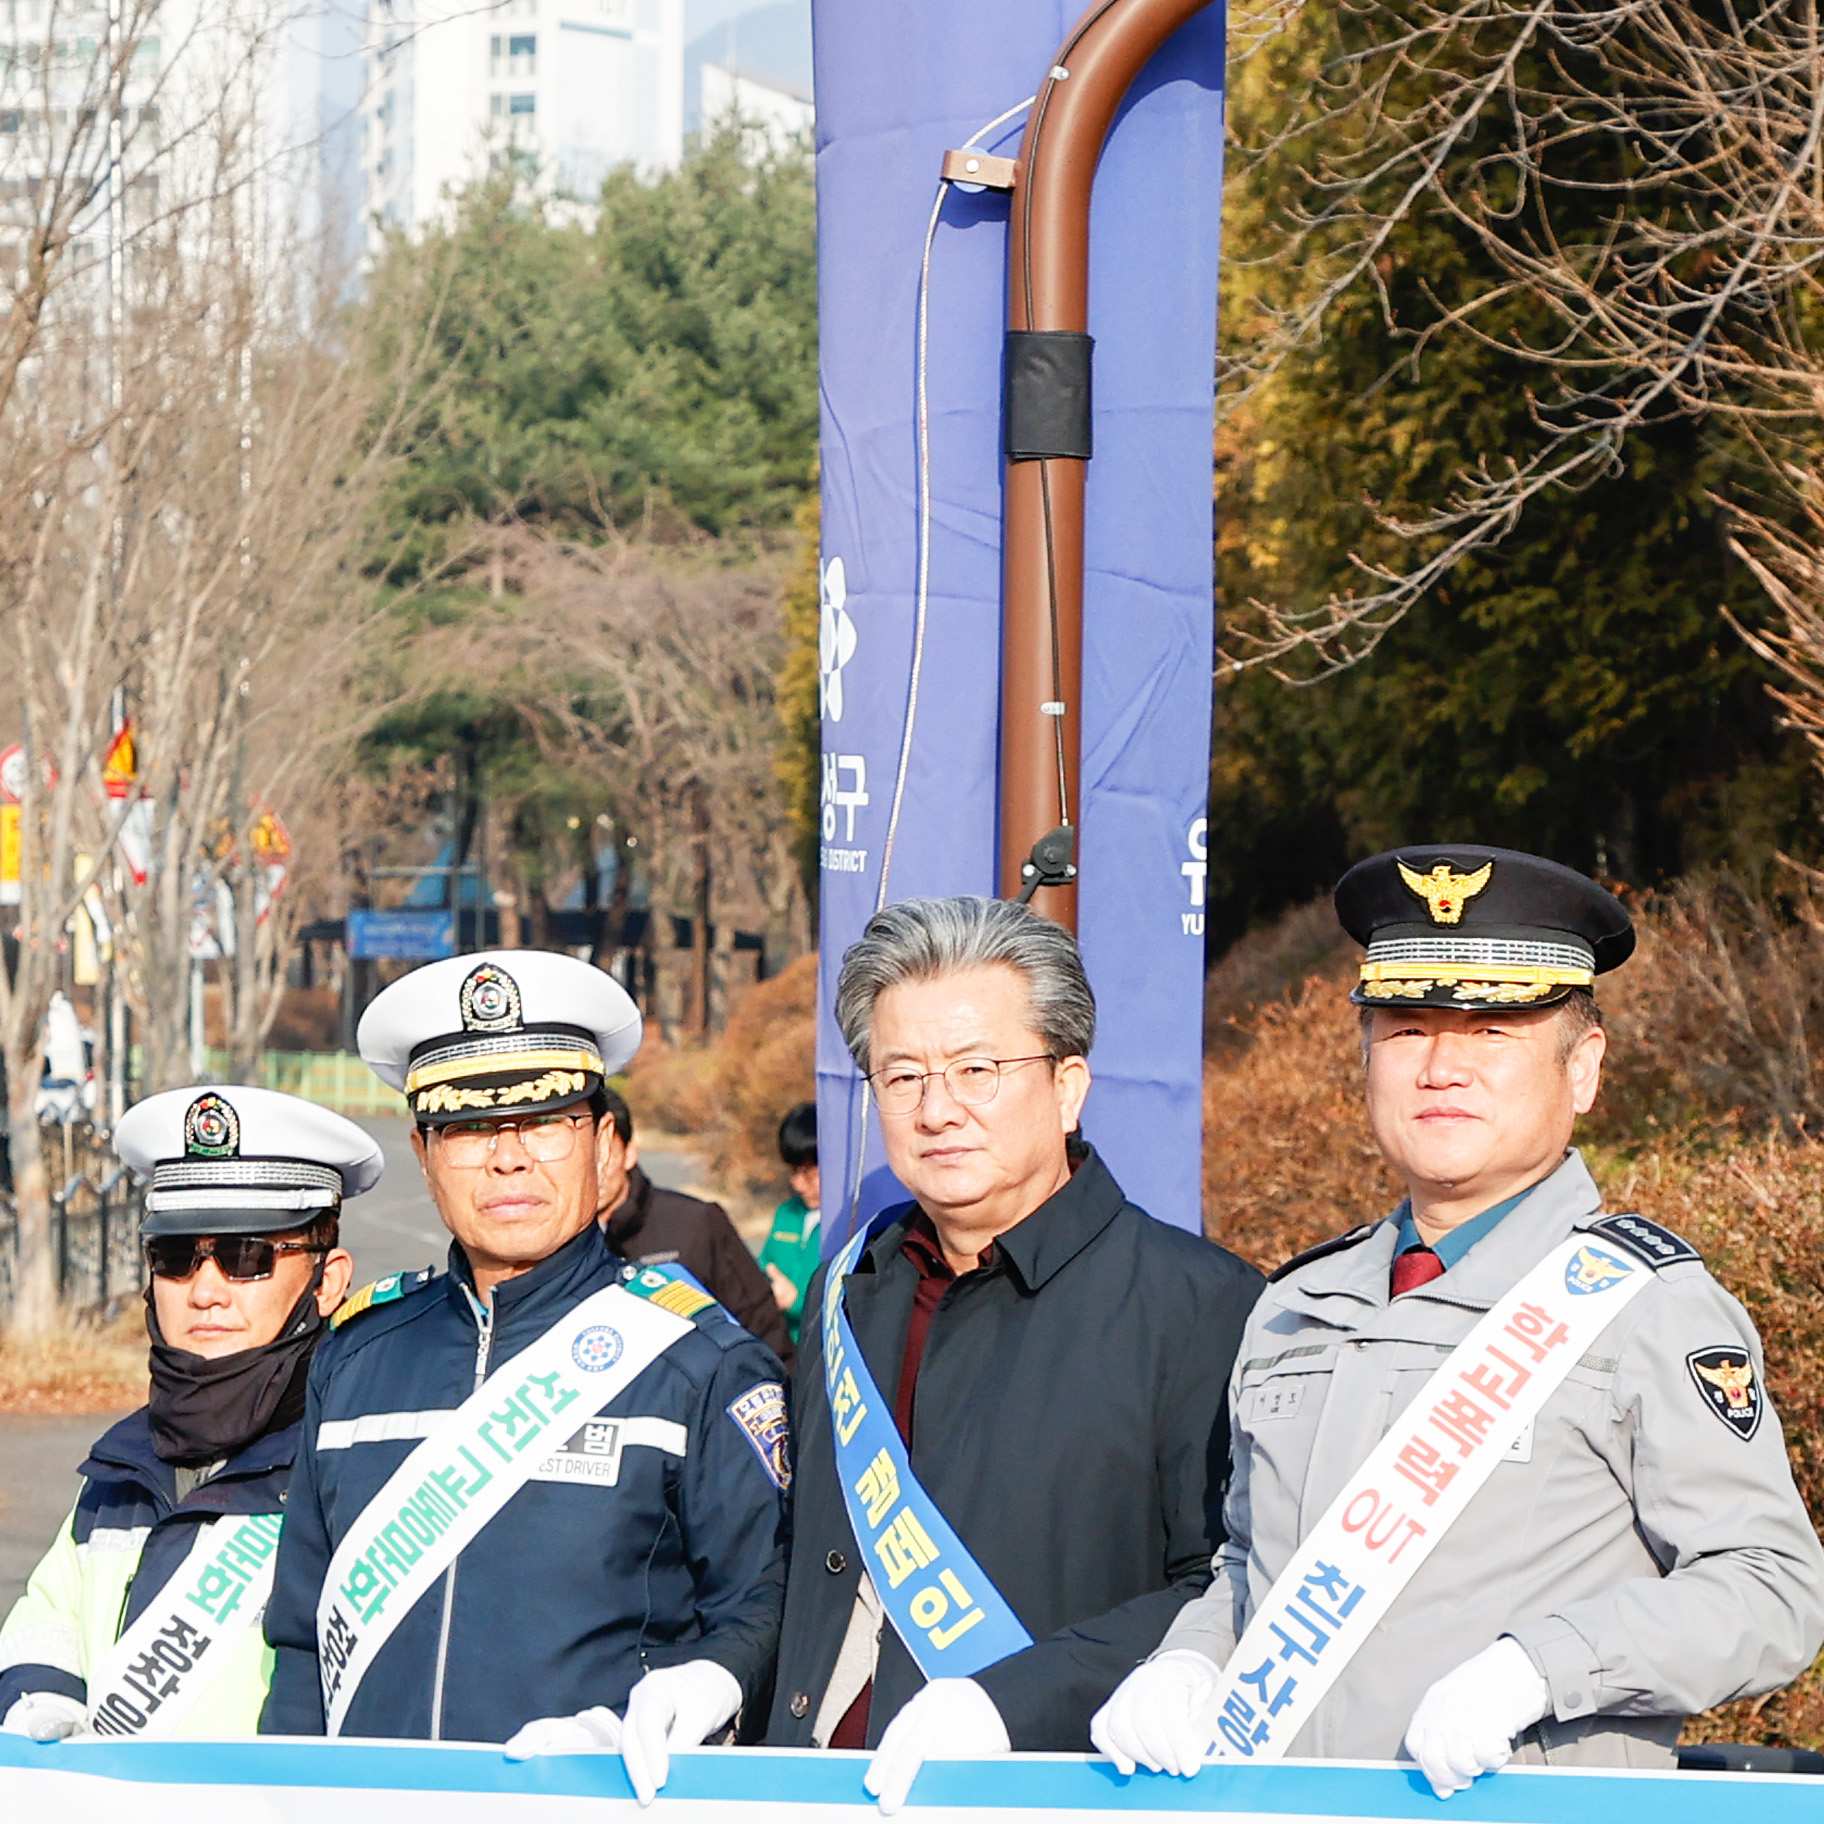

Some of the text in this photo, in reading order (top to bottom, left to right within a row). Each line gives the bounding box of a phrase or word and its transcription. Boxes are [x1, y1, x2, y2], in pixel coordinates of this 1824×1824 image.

[479, 1373, 578, 1461] 선진
[565, 1459, 610, 1477] DRIVER
[341, 1447, 492, 1624] 교통문화
[859, 1433, 981, 1647] 캠페인
[1217, 1303, 1568, 1757] 학교폭력 OUT 친구사랑
